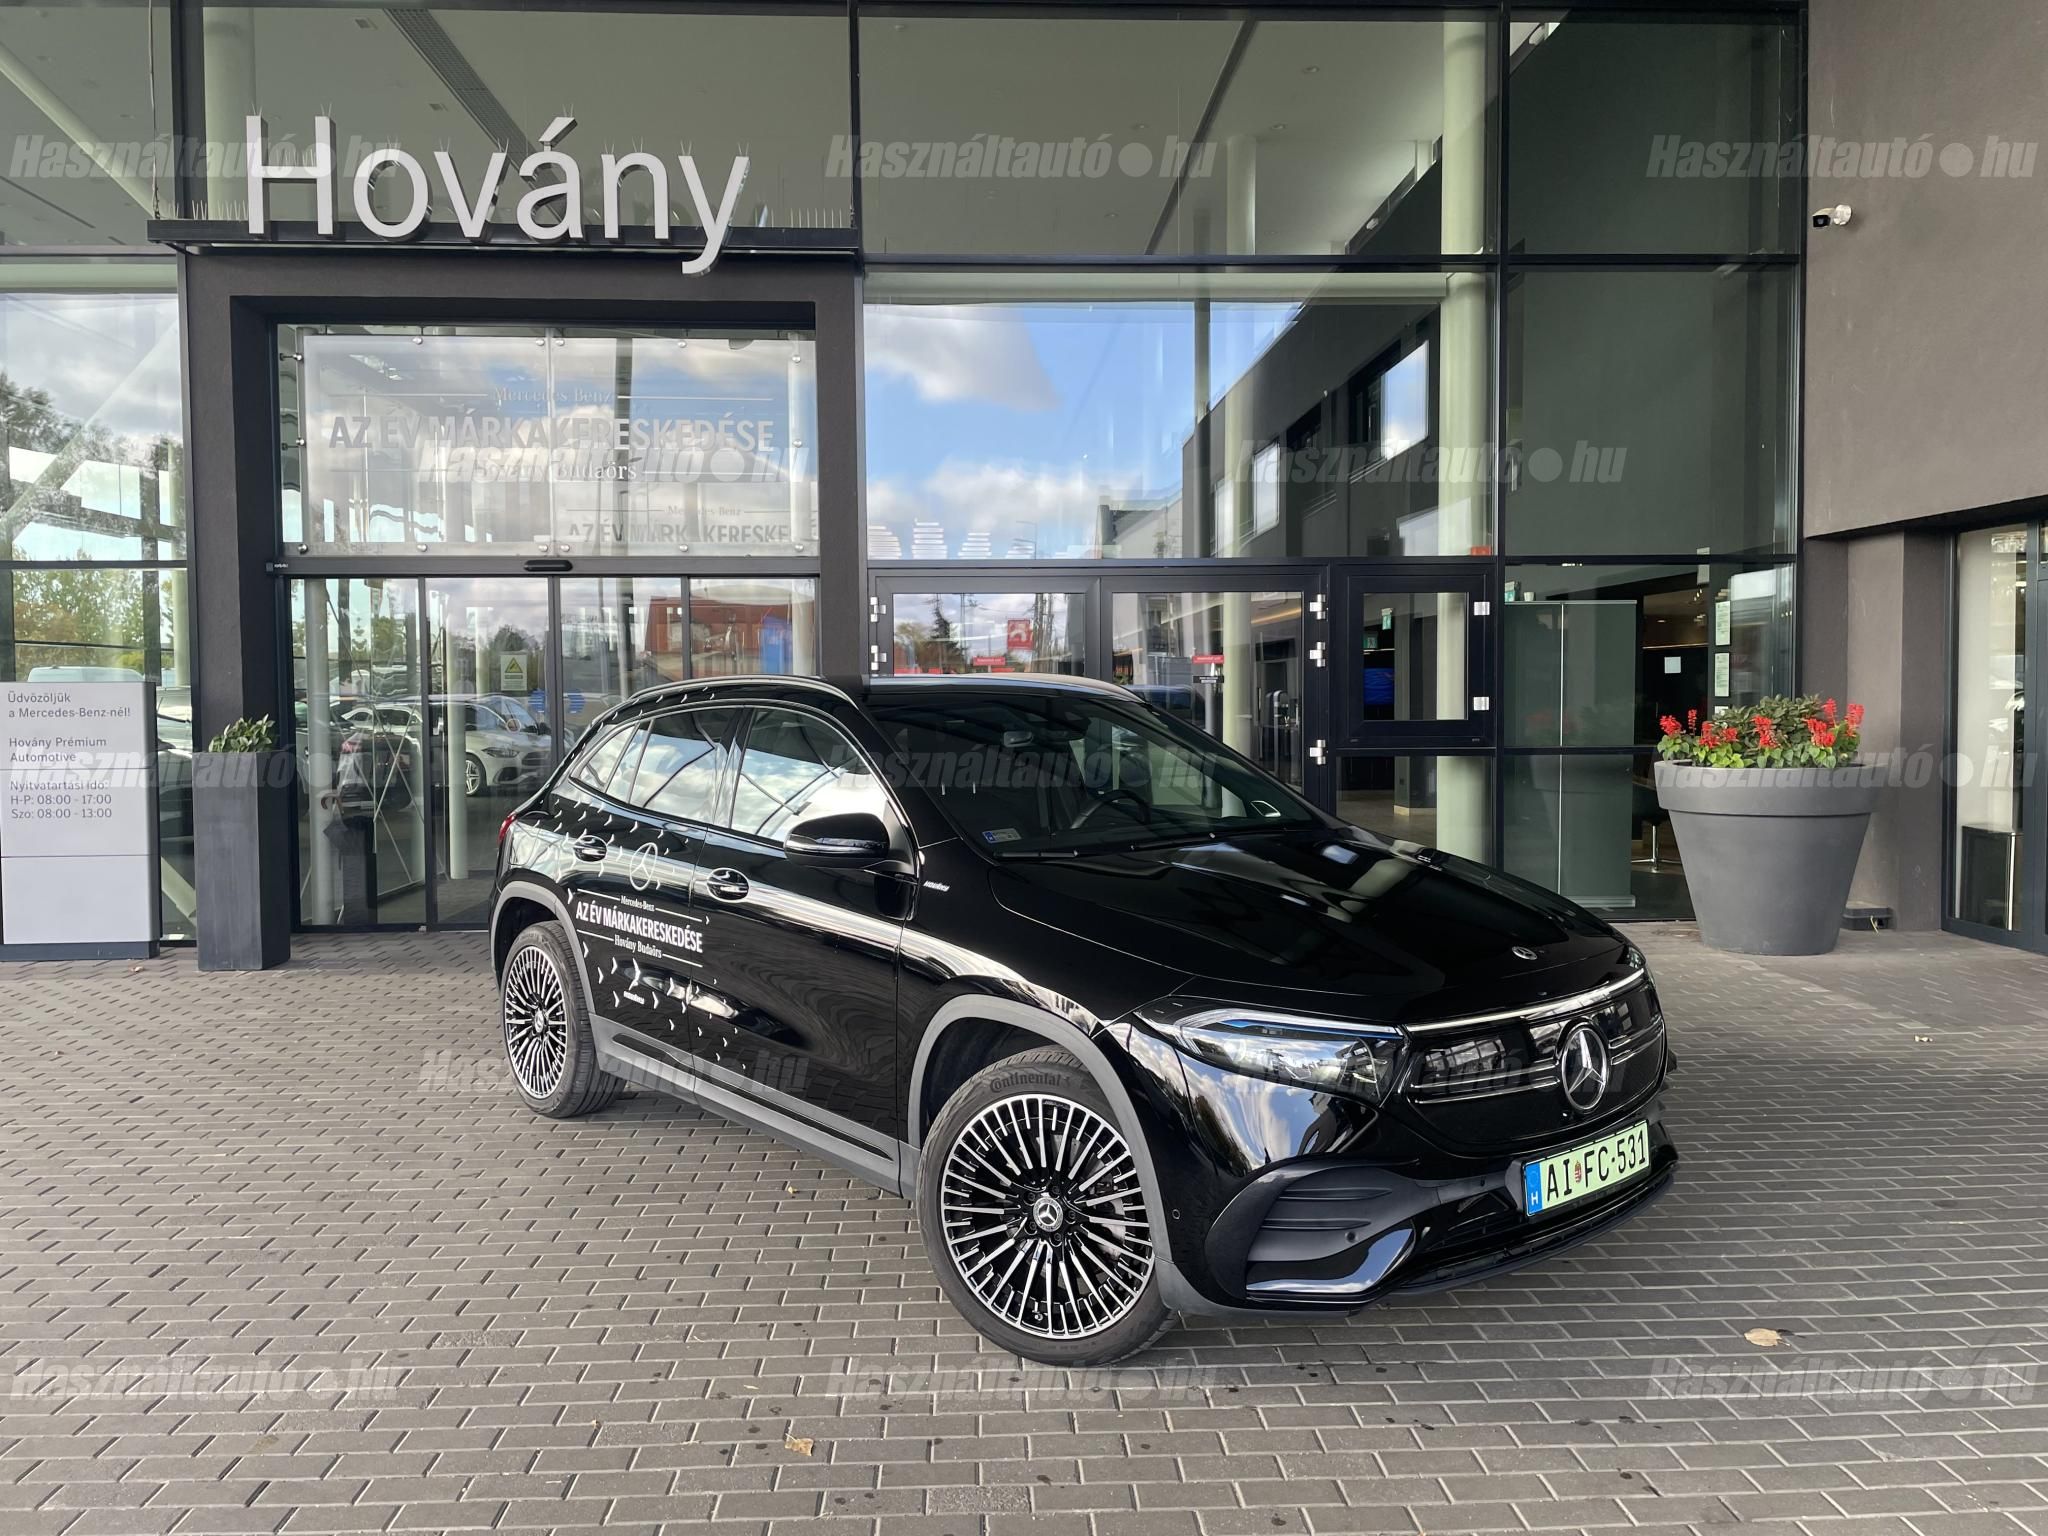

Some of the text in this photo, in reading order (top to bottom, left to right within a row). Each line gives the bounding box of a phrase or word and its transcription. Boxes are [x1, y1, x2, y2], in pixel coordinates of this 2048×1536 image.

[246, 115, 750, 276] Hovány
[329, 416, 372, 449] AZ
[429, 407, 774, 452] MÁRKAKERESKEDÉSE
[7, 690, 72, 705] Üdvözöljük
[8, 710, 15, 718] a
[9, 737, 107, 750] Hovány Prémium
[10, 752, 77, 763] Automotive
[10, 794, 34, 805] H-P:
[37, 794, 71, 805] 08:00
[82, 794, 112, 805] 17:00
[11, 808, 34, 819] Szo:
[37, 808, 71, 819] 08:00
[82, 808, 112, 819] 13:00
[620, 895, 655, 912] Mercedes-Benz
[576, 900, 703, 953] AZ ÉV MÁRKAKERESKEDÉSE
[614, 934, 662, 959] Hovány Budaörs
[989, 1071, 1061, 1093] Continental
[1530, 1191, 1539, 1206] H
